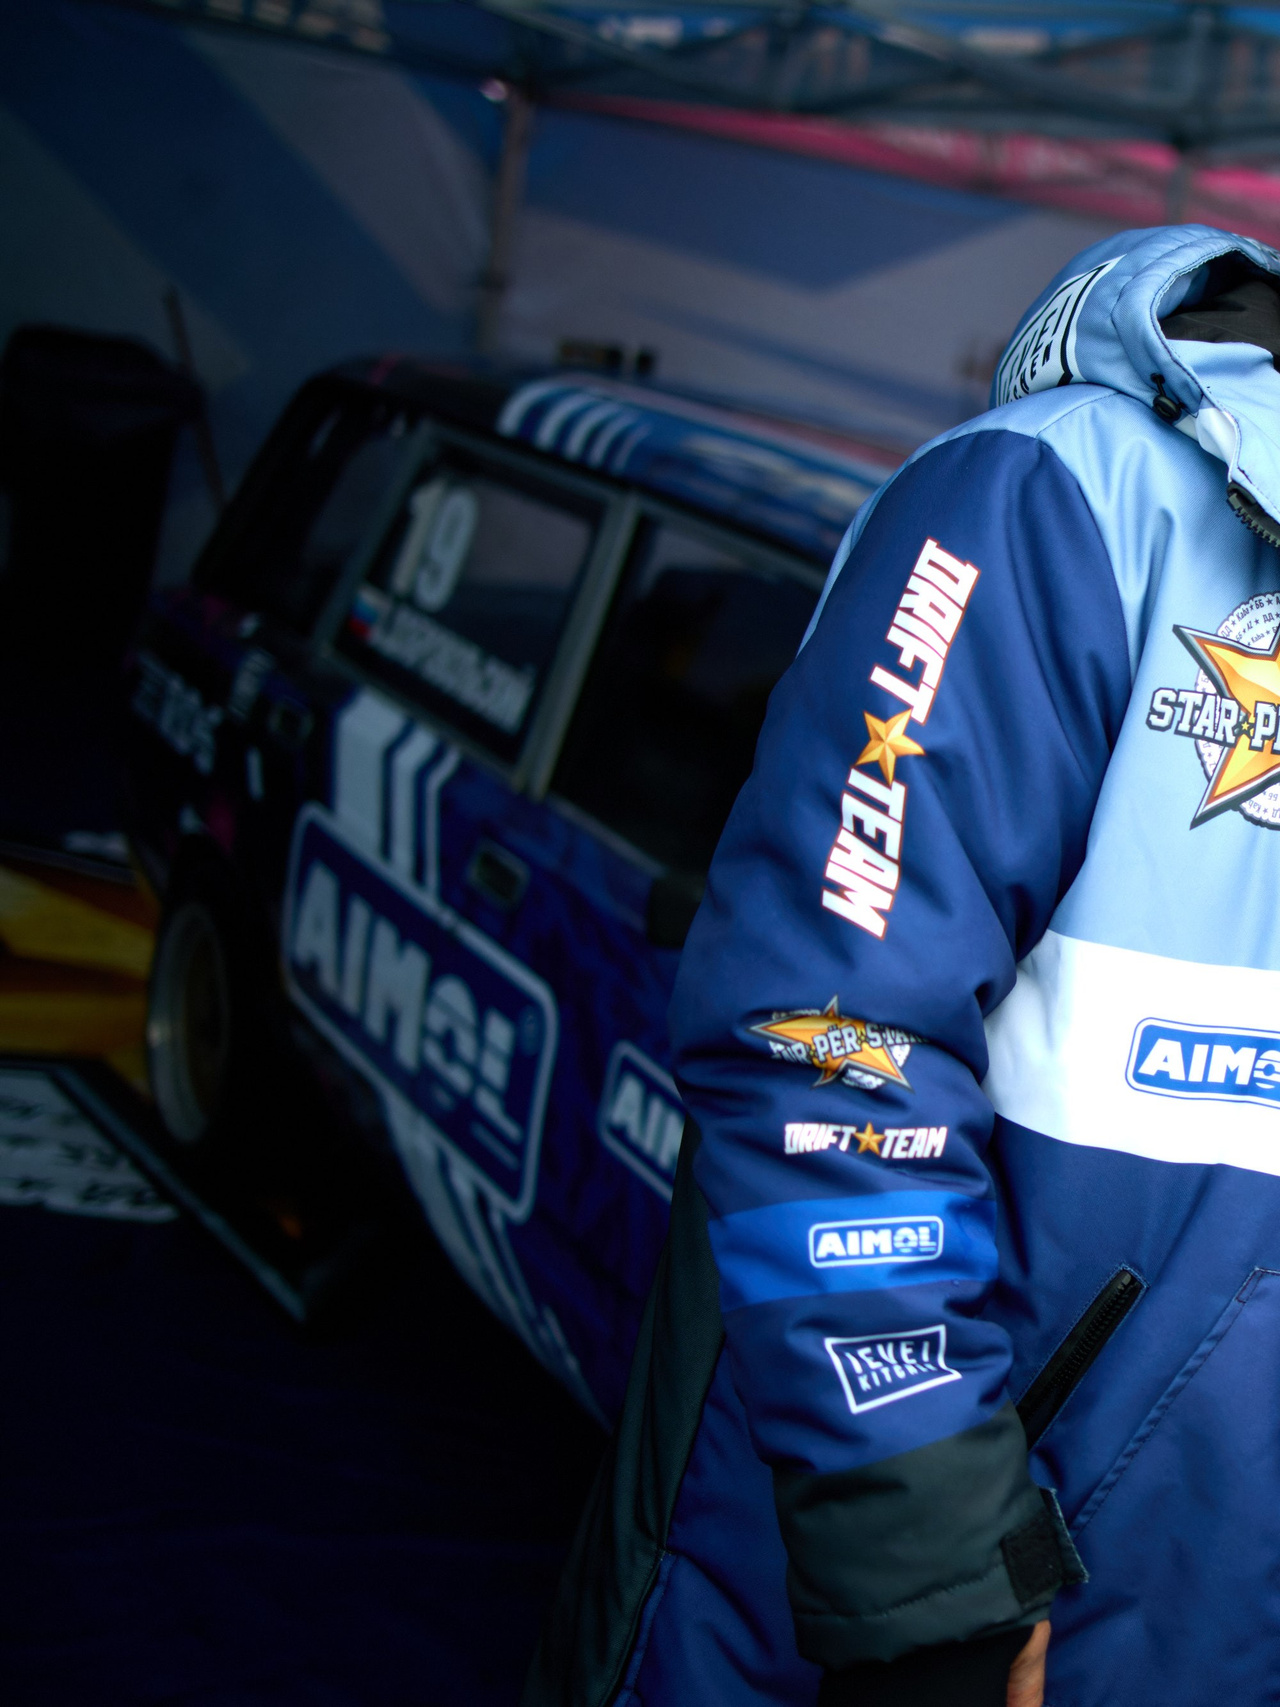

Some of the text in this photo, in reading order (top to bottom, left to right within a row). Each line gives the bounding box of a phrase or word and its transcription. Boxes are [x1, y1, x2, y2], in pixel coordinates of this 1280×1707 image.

[394, 478, 478, 613] 19
[821, 536, 982, 940] DRIFT TEAM
[1147, 687, 1238, 746] STAR
[784, 1122, 948, 1159] DRIFT TEAM
[816, 1226, 938, 1259] AIMOL
